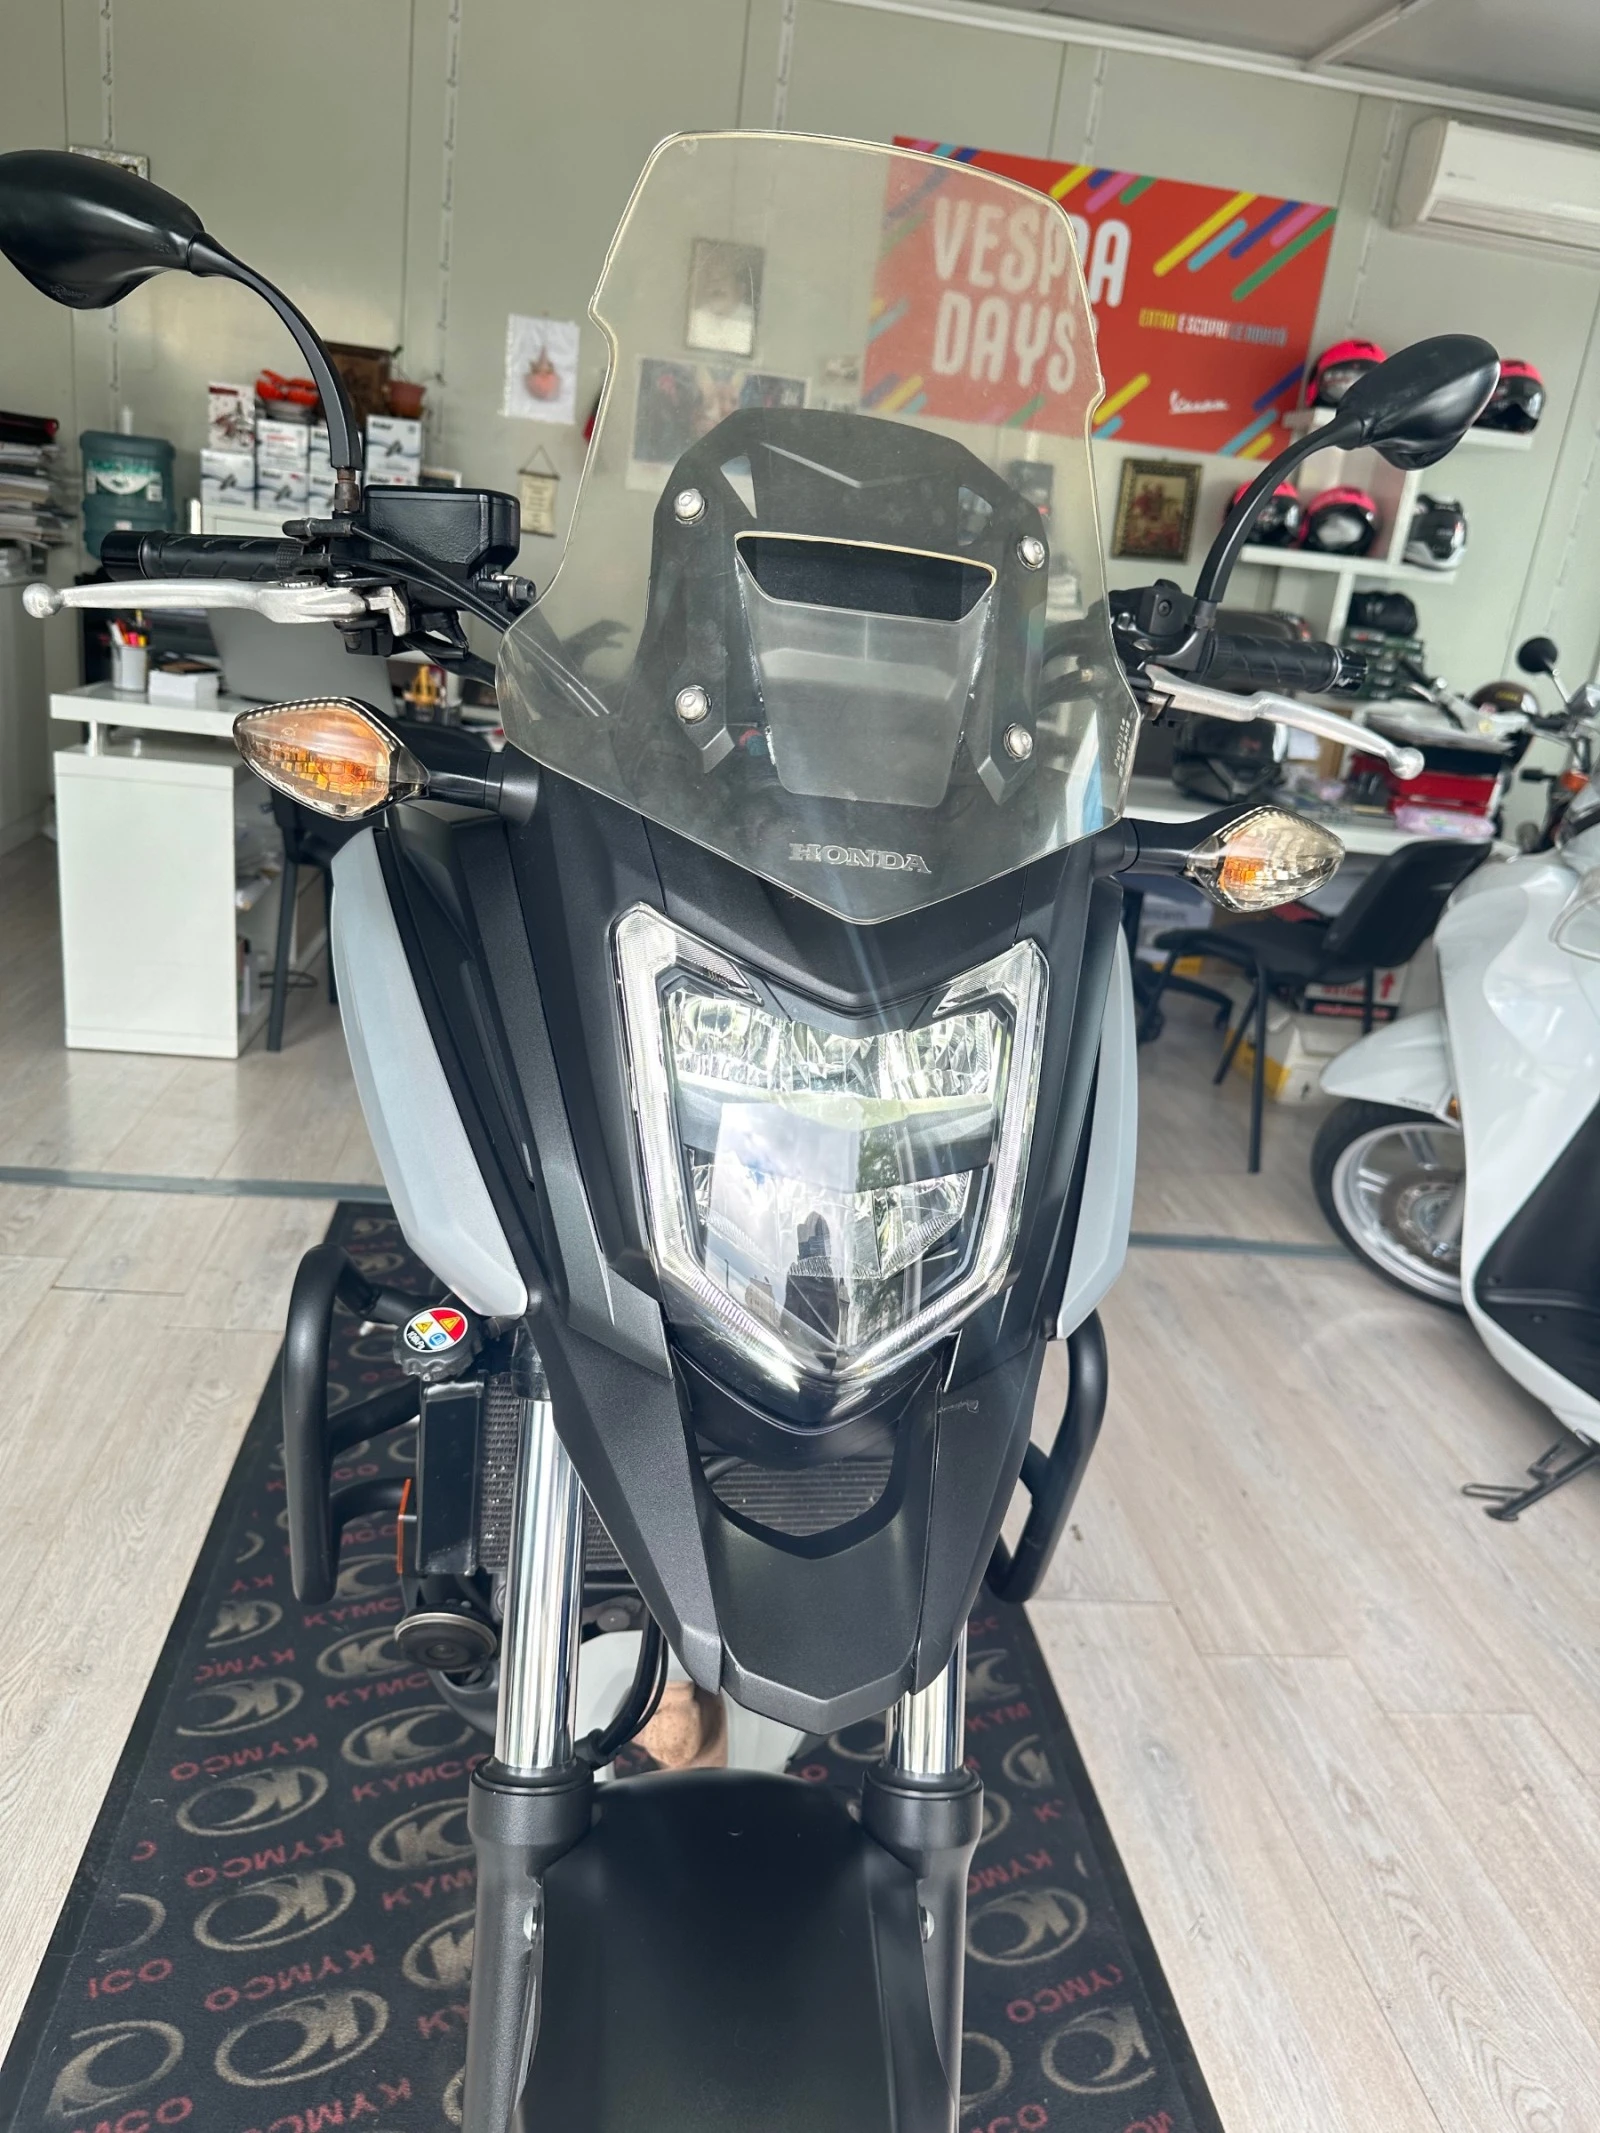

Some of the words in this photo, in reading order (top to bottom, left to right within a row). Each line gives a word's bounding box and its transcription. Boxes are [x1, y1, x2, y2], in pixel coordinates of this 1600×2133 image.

[932, 197, 1132, 308] VESPA
[930, 291, 1078, 394] DAYS
[789, 843, 932, 874] HONDA
[325, 1671, 430, 1709] KYMC
[170, 1733, 319, 1781] KYMCO
[184, 1829, 346, 1889] KYMCO
[204, 1943, 376, 2012] KYMCO
